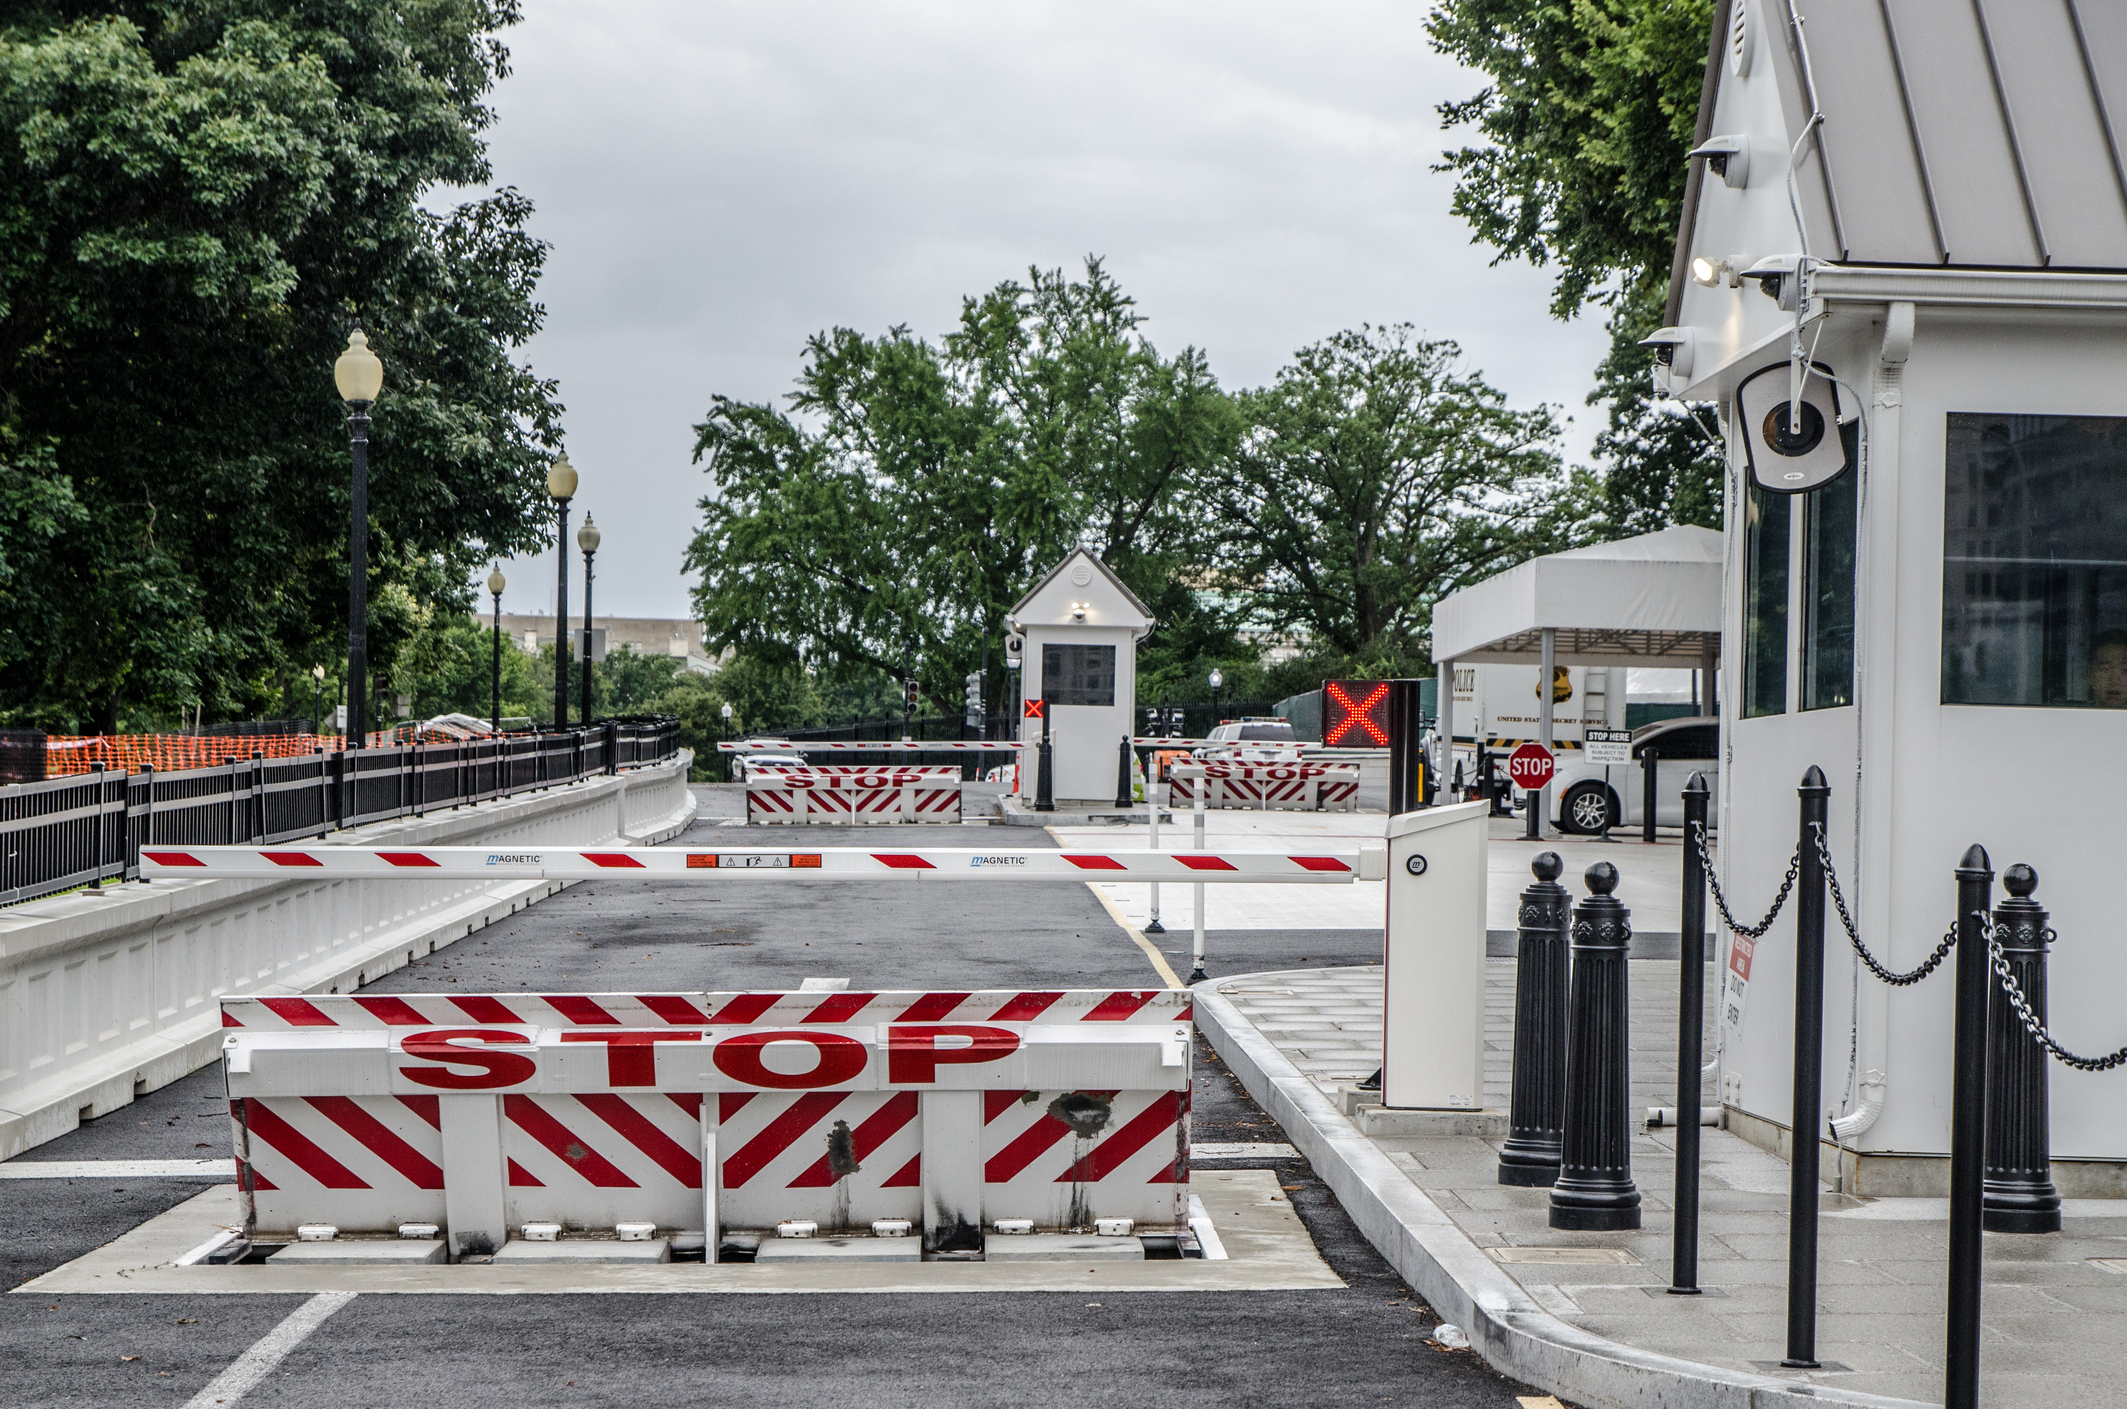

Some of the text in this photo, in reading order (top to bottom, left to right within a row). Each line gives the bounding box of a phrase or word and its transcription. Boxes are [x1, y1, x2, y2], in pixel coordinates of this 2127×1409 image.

[1453, 669, 1475, 692] OLICE
[1588, 731, 1630, 742] STOP HERE
[1205, 766, 1326, 780] STOP
[1512, 757, 1552, 776] STOP
[784, 774, 922, 789] STOP
[1730, 974, 1745, 998] DO NOT
[1727, 1003, 1739, 1026] ENTER
[398, 1023, 1022, 1090] STOP
